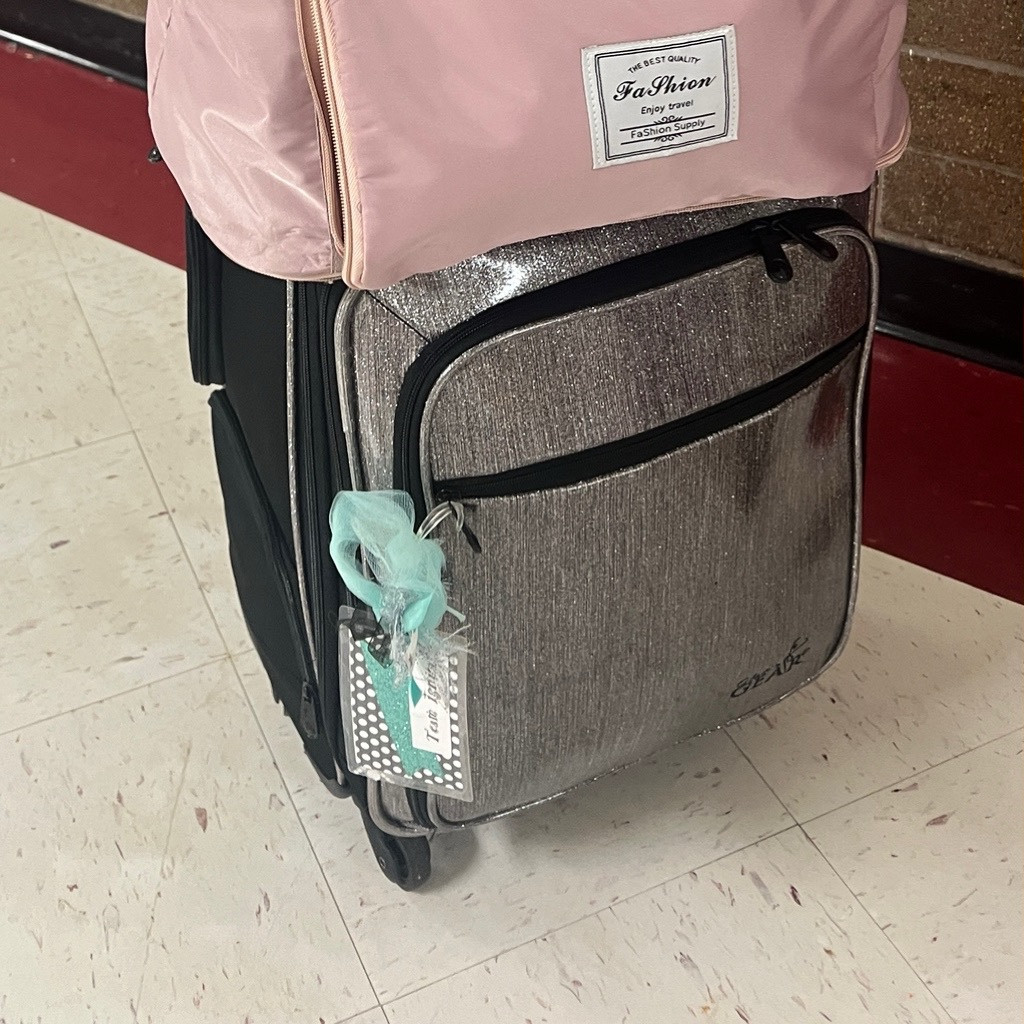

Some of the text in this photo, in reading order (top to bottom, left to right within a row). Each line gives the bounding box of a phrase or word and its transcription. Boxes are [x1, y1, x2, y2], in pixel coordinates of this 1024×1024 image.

[628, 55, 701, 74] THE BEST QUALITY
[613, 75, 717, 102] FaShion
[640, 99, 694, 116] Enjoy travel
[630, 119, 706, 139] FaShion Supply
